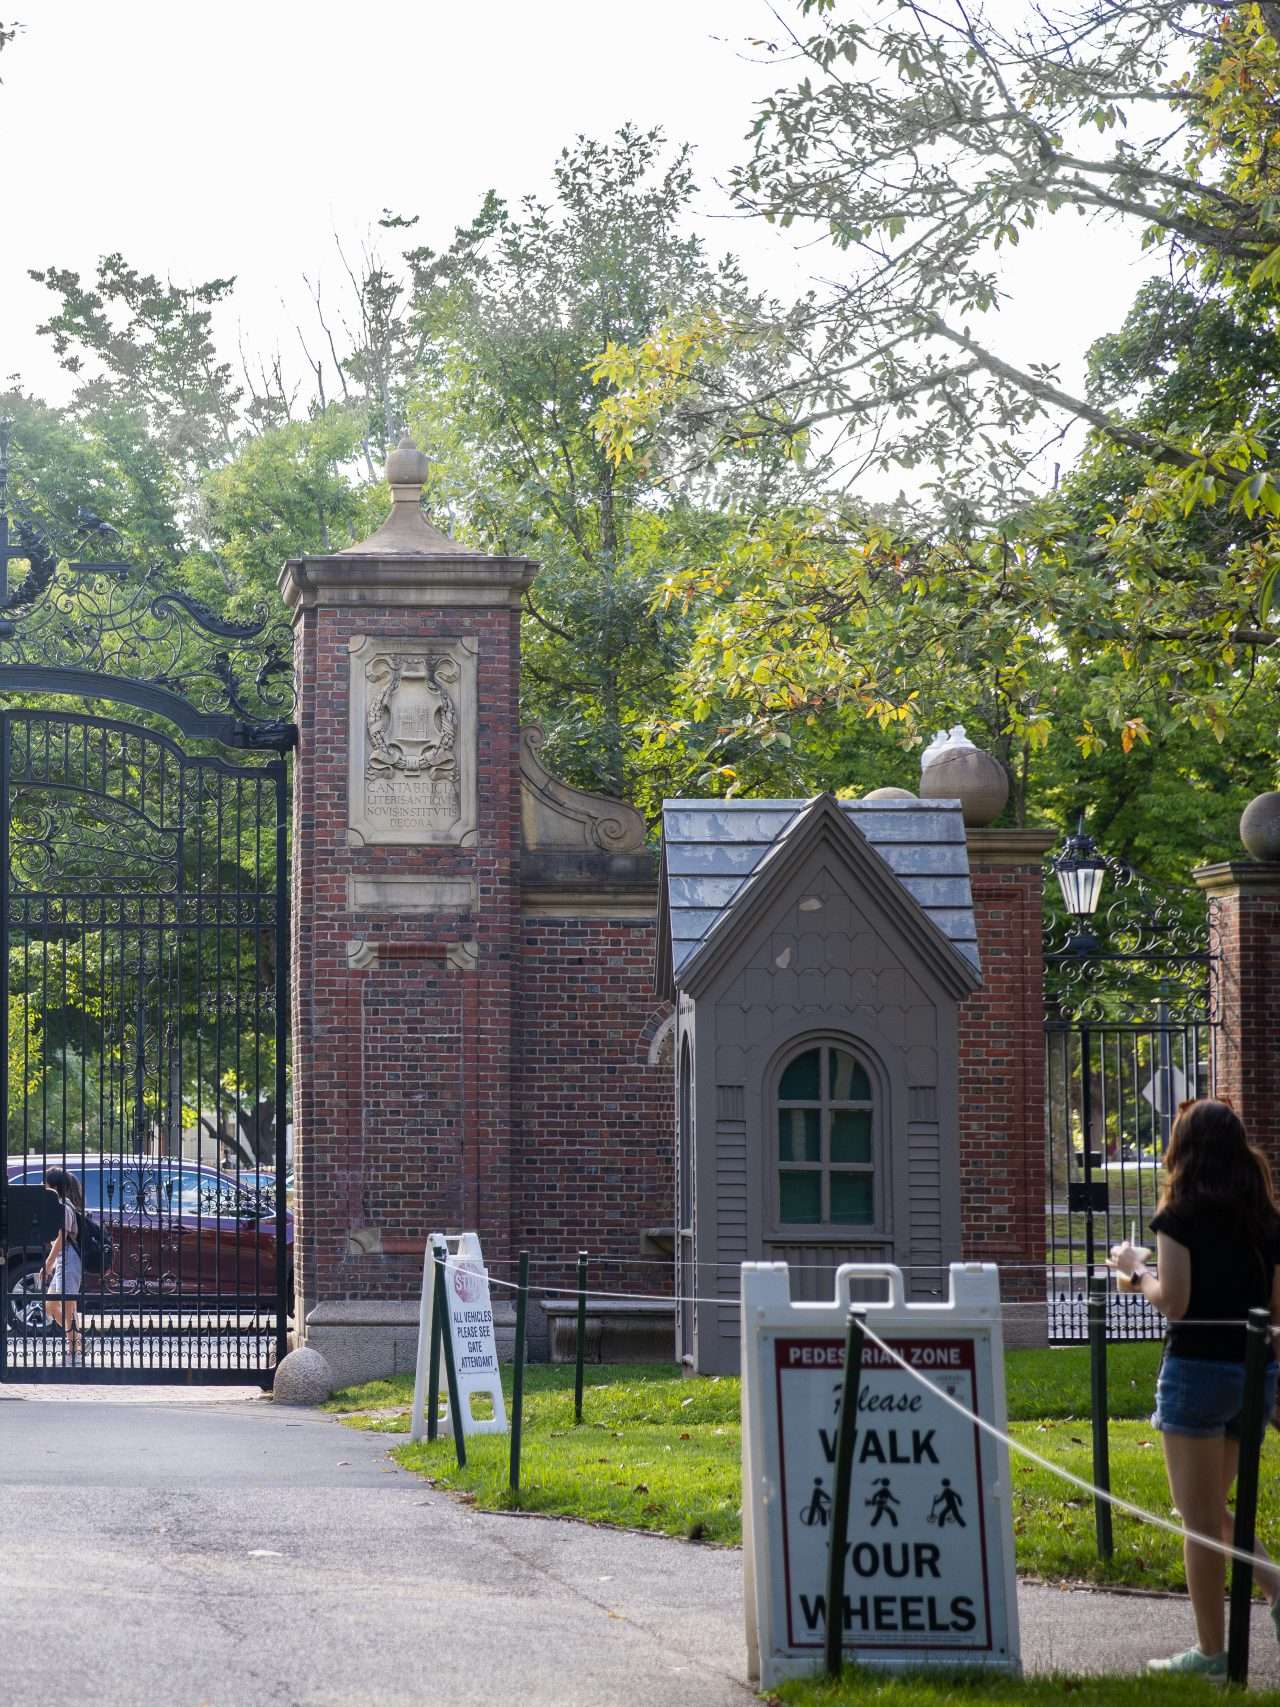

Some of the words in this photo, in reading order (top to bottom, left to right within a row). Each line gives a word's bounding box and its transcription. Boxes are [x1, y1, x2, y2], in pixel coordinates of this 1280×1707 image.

[453, 1312, 463, 1324] ALL
[464, 1310, 492, 1323] VEHICLES
[457, 1326, 478, 1338] PLEASE
[478, 1326, 491, 1337] SEE
[468, 1341, 483, 1353] GATE
[461, 1355, 493, 1369] ATTENDANT
[788, 1347, 906, 1365] PEDESRIAN
[910, 1347, 961, 1365] ZONE
[799, 1594, 977, 1632] WHEELS
